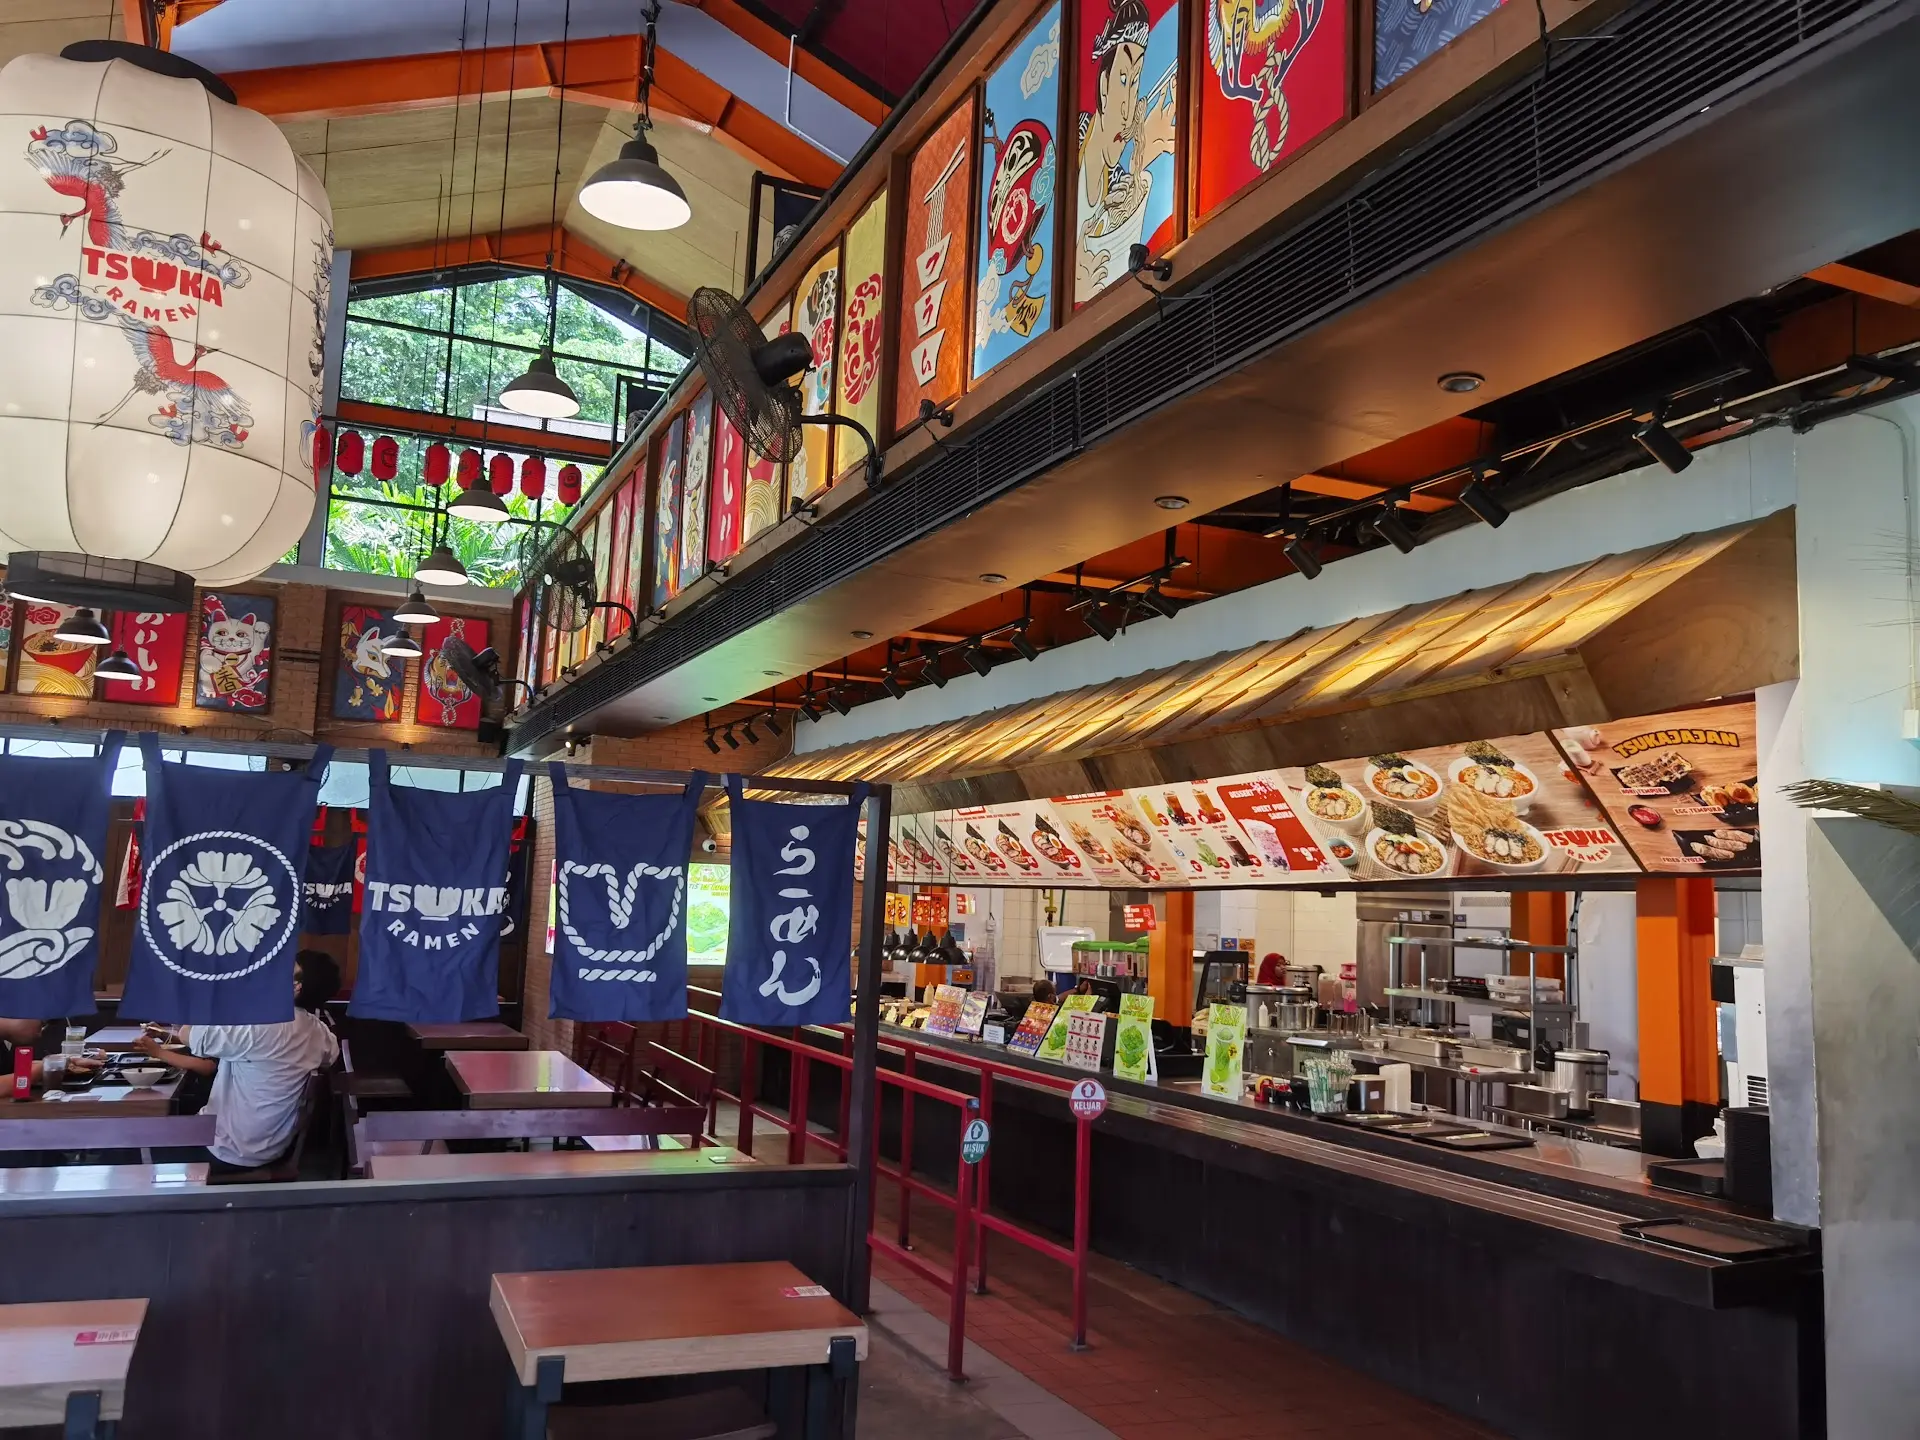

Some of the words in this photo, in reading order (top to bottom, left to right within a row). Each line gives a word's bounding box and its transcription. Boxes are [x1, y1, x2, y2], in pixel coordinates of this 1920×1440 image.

[82, 247, 223, 307] TSUKA
[107, 286, 197, 322] RAMEN
[720, 414, 734, 541] いしい
[1612, 729, 1740, 758] TSUKAJAJAN
[1689, 805, 1723, 813] TEMPURA
[1543, 829, 1617, 848] TSUKA
[1567, 847, 1609, 862] RAMEN
[305, 896, 340, 910] RAMEN
[368, 881, 504, 921] TSUKA
[387, 918, 480, 950] RAMEN
[1073, 1100, 1102, 1111] KELUAR
